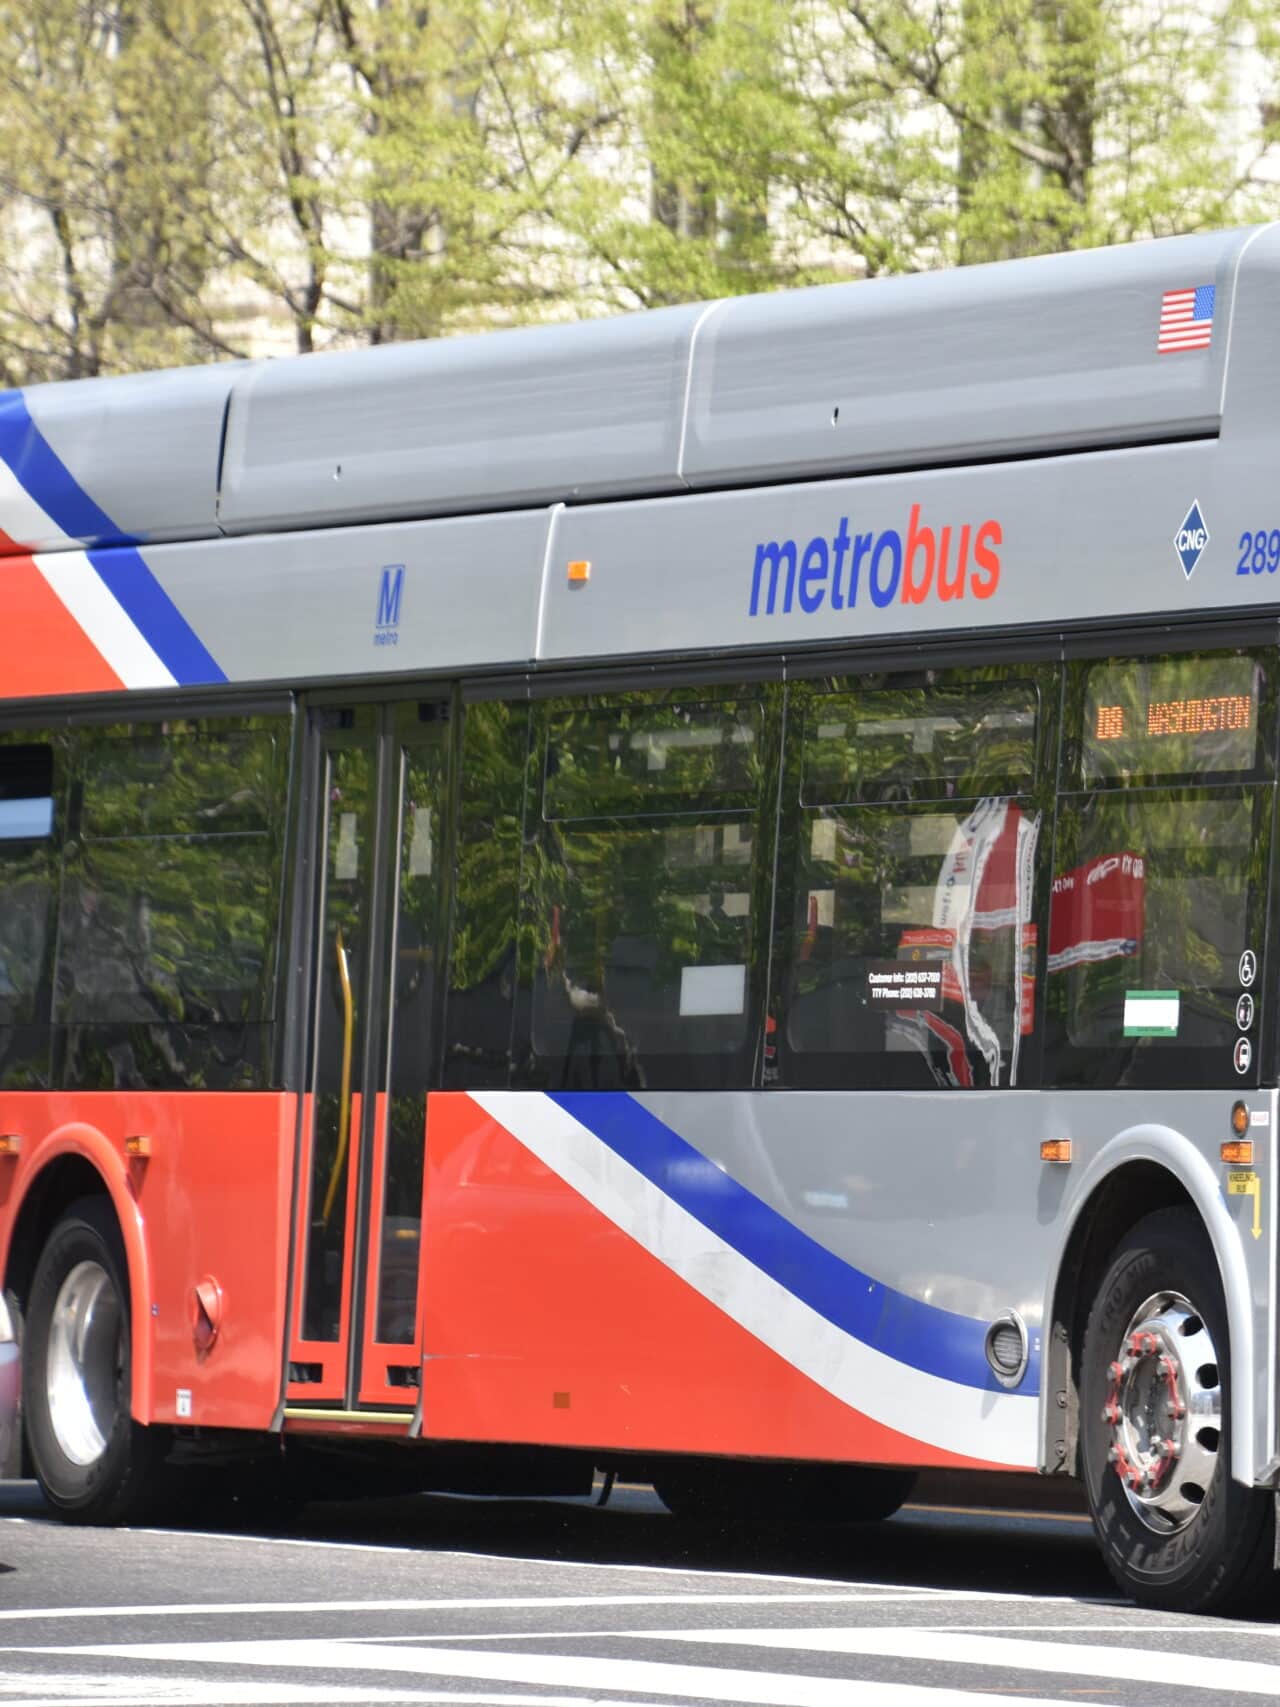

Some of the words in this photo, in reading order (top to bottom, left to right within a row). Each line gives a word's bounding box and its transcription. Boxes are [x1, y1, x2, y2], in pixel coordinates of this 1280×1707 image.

[748, 503, 1002, 617] metrobus
[1178, 528, 1205, 551] CNG
[1147, 695, 1251, 736] WASHINGTON
